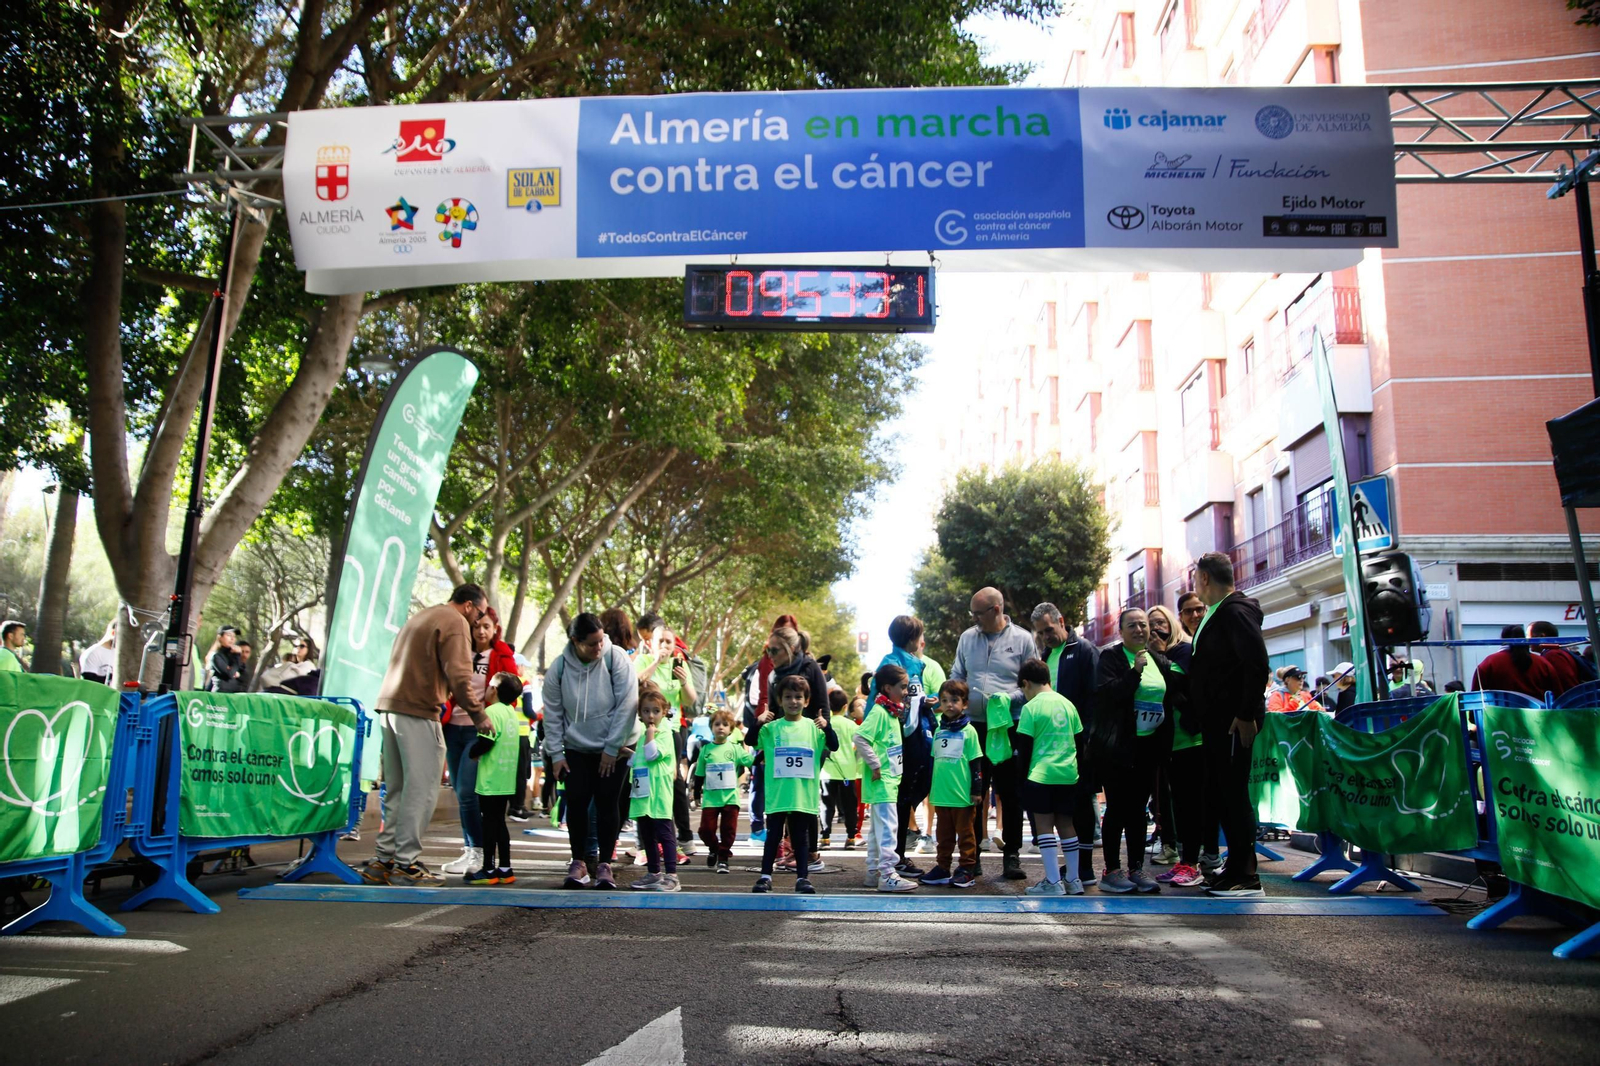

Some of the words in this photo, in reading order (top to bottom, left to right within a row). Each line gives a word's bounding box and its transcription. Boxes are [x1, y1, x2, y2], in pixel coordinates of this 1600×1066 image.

[1138, 109, 1227, 132] cajamar
[1294, 113, 1371, 123] UNIVERSIDAD
[610, 108, 790, 145] Almería
[805, 114, 860, 139] en
[877, 104, 1051, 138] marcha
[1295, 122, 1312, 132] DE
[1316, 120, 1372, 132] ALMERÍA
[609, 157, 760, 196] contra
[774, 153, 819, 190] el
[831, 152, 993, 190] cáncer
[1229, 158, 1331, 179] Fundación
[1144, 171, 1206, 179] MICHELIN
[513, 187, 522, 197] DE
[1282, 195, 1317, 212] Ejido
[1321, 196, 1365, 209] Motor
[299, 206, 364, 224] ALMERÍA
[973, 210, 1026, 221] asociación
[1028, 210, 1071, 221] española
[1151, 205, 1195, 217] Toyota
[316, 224, 351, 234] CIUDAD
[975, 222, 1006, 231] contra
[1008, 222, 1017, 230] el
[1018, 222, 1051, 230] cáncer
[1151, 220, 1202, 231] Alborán
[1205, 220, 1244, 231] Motor
[1306, 223, 1326, 233] Jeep
[409, 235, 427, 244] 2005
[598, 229, 748, 244] #TodosContraElCáncer
[975, 233, 986, 241] en
[990, 231, 1030, 241] Almería
[387, 448, 401, 466] un
[399, 458, 421, 483] gran
[383, 464, 417, 496] camino
[377, 478, 396, 497] por
[374, 493, 412, 526] delante
[941, 738, 949, 748] 3
[187, 744, 227, 764] Contra
[230, 748, 243, 765] el
[246, 750, 284, 768] cáncer
[785, 756, 804, 768] 95
[717, 772, 724, 781] 1
[1545, 814, 1583, 837] solo
